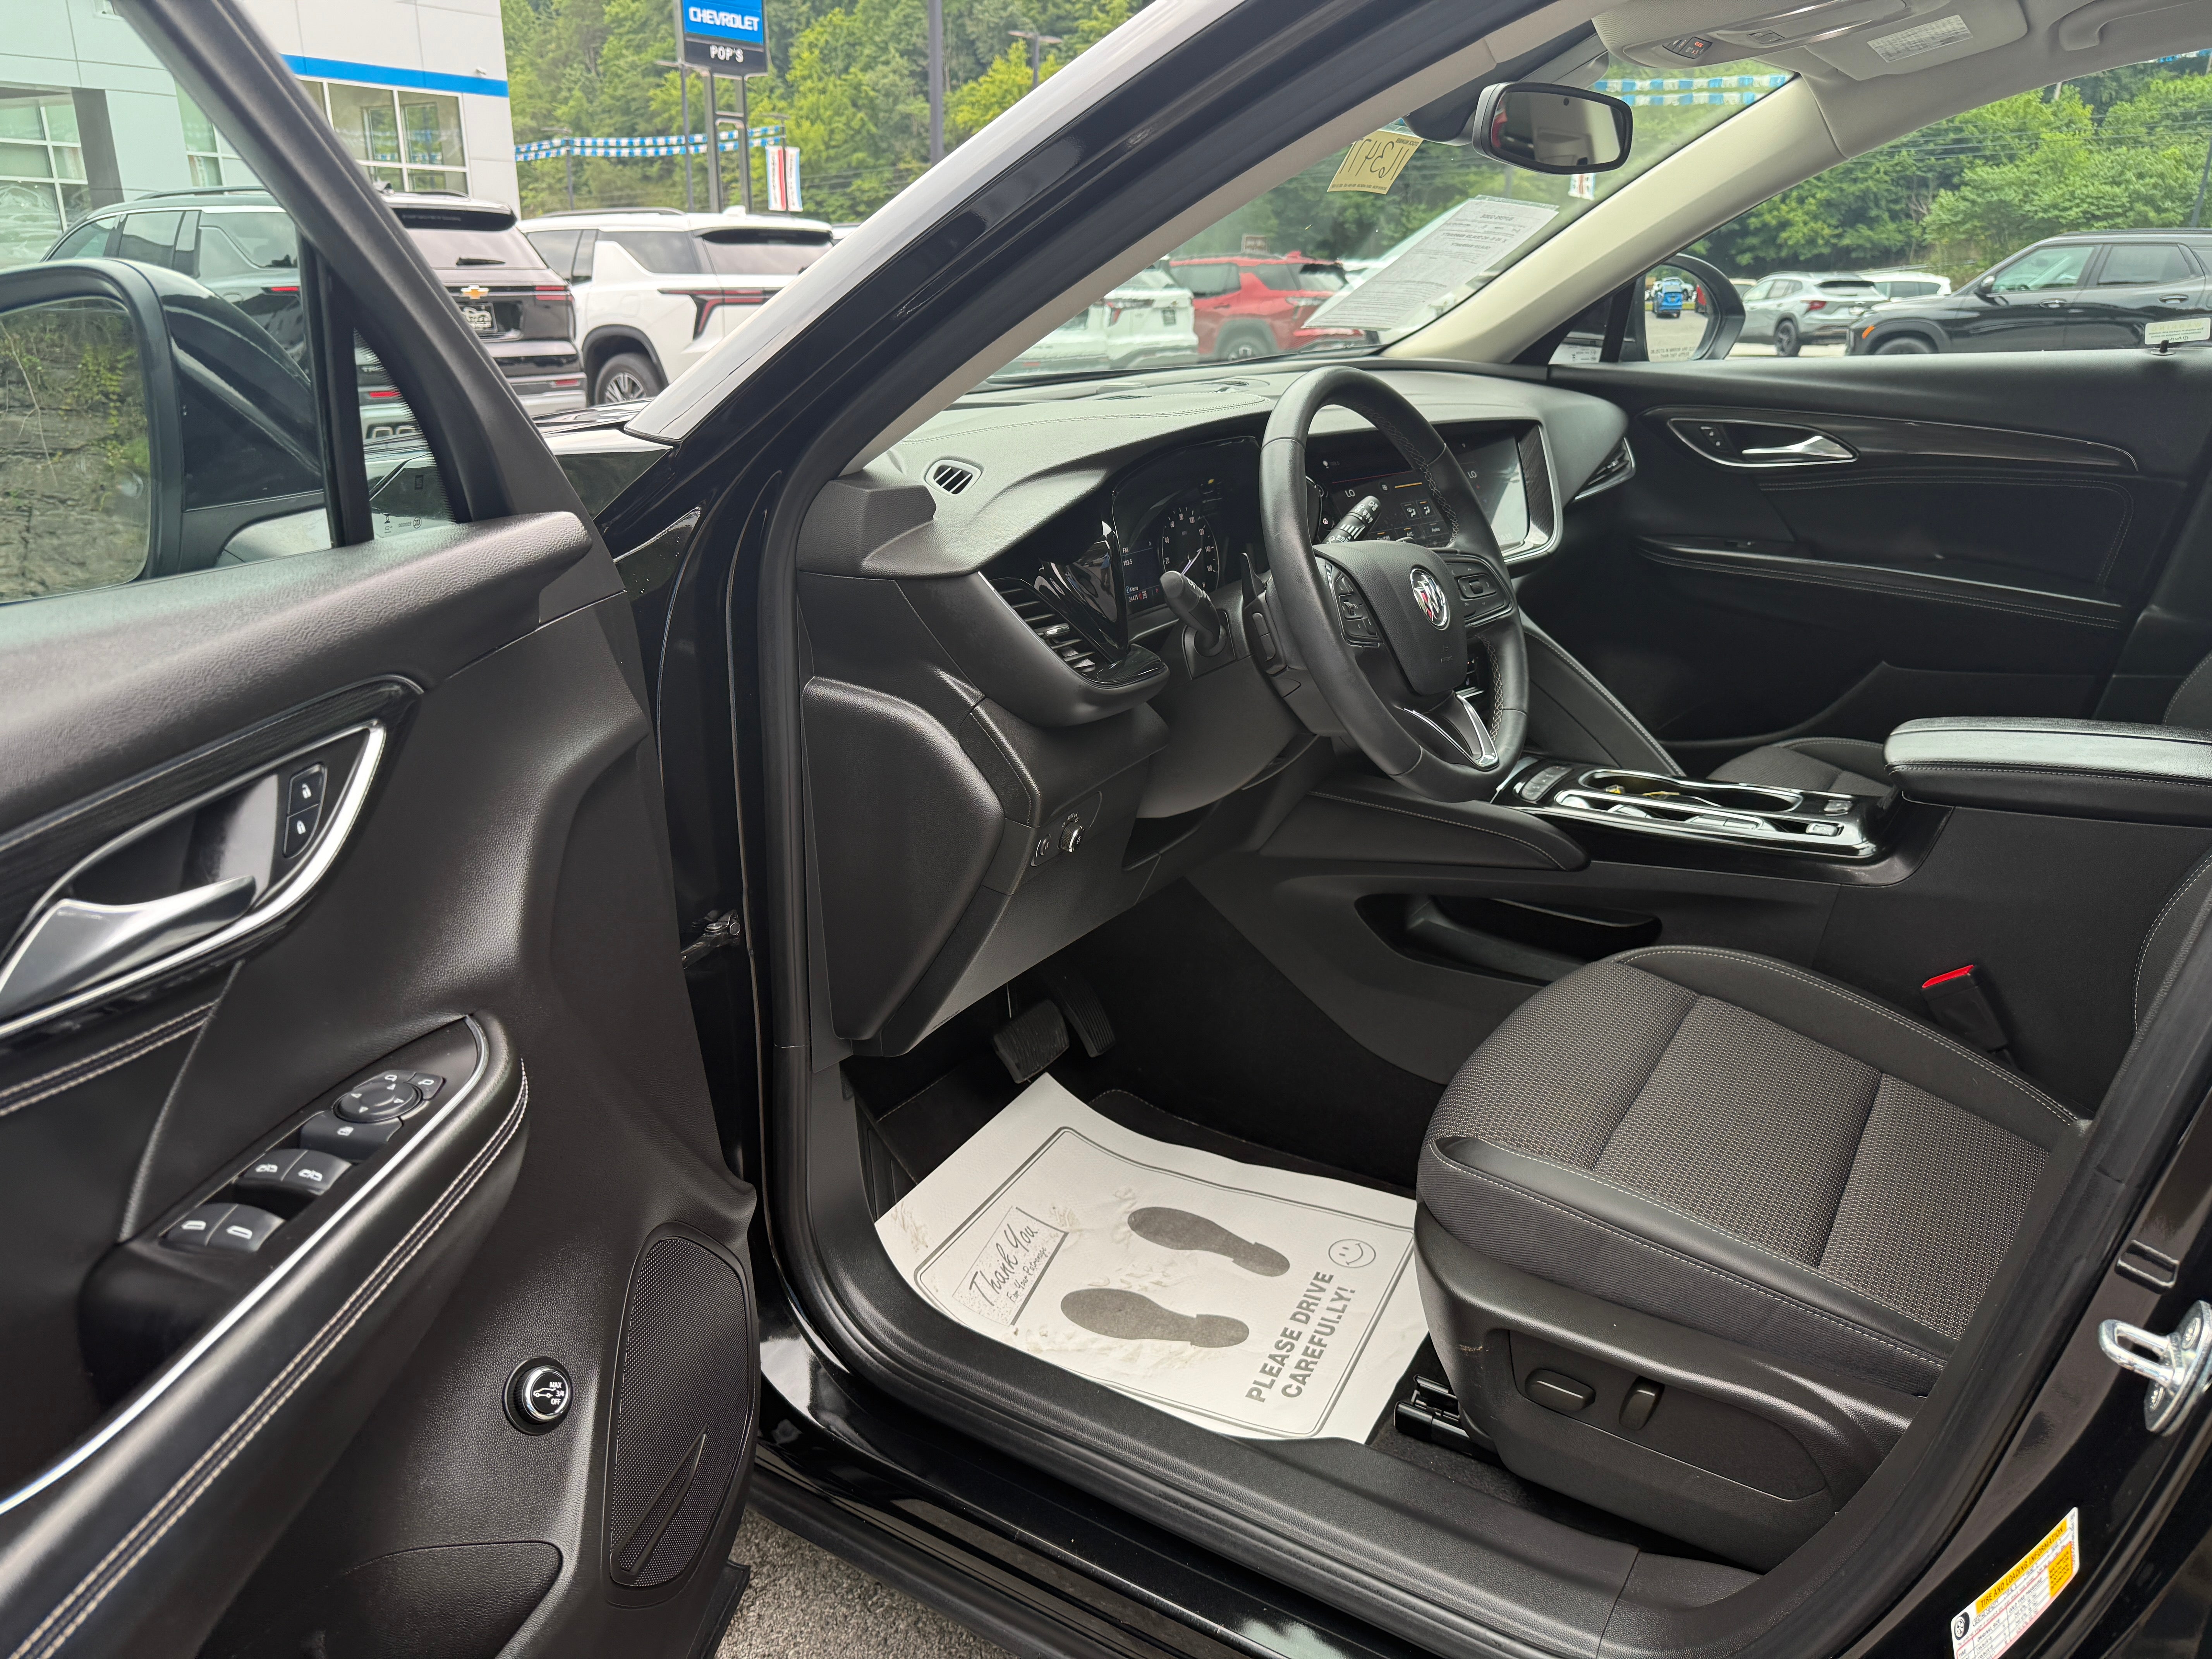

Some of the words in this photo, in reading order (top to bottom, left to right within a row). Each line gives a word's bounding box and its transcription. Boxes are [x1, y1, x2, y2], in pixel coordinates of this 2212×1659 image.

[689, 6, 759, 31] CHEVROLET
[710, 45, 744, 63] POP'S
[1345, 489, 1355, 498] LO
[1467, 471, 1477, 479] LO
[969, 1243, 1018, 1306] Thank
[1004, 1223, 1038, 1252] You
[1006, 1290, 1019, 1303] For
[1014, 1276, 1028, 1289] Your
[1023, 1247, 1048, 1275] Patronage
[1245, 1327, 1303, 1403] PLEASE
[1289, 1271, 1334, 1324] DRIVE
[1281, 1286, 1355, 1398] CAREFULLY!
[1980, 1593, 1992, 1607] TIRE
[1994, 1582, 2004, 1596] AND
[2006, 1561, 2028, 1585] LOADING
[2029, 1525, 2063, 1565] INFORMATION
